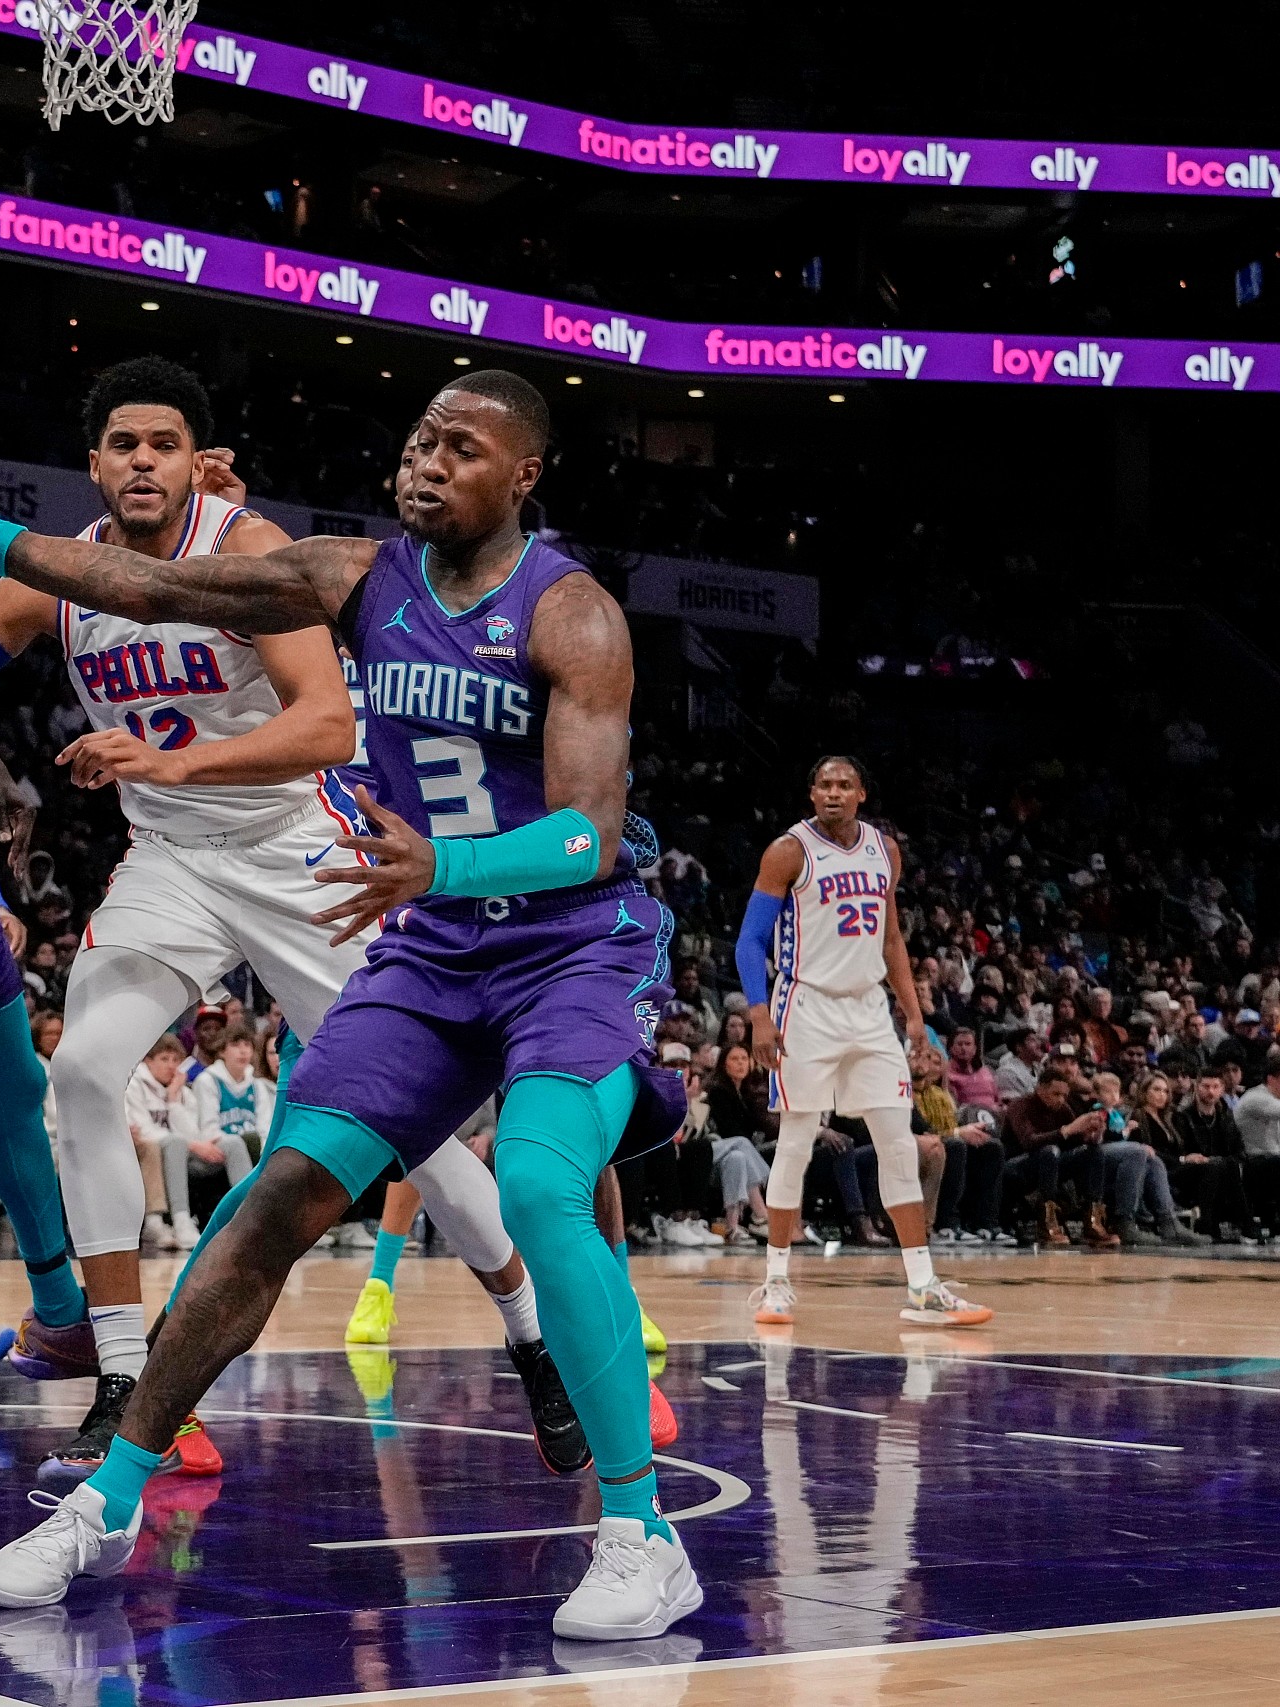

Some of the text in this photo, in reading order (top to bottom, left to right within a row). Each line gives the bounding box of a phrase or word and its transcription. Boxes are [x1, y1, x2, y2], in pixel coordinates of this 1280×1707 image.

[307, 61, 368, 111] ally
[423, 83, 528, 147] locally
[578, 119, 780, 178] fanatically
[843, 138, 971, 186] loyally
[1030, 147, 1099, 191] ally
[264, 250, 380, 316] loyally
[430, 287, 489, 336] ally
[543, 304, 647, 364] locally
[704, 328, 928, 380] fanatically
[992, 339, 1124, 386] loyally
[1184, 347, 1254, 391] ally
[72, 640, 230, 704] PHILA
[474, 646, 517, 657] FEASTABLES
[368, 660, 533, 737] HORNETS
[410, 734, 500, 839] 3
[817, 871, 888, 905] PHILA
[836, 902, 880, 937] 25
